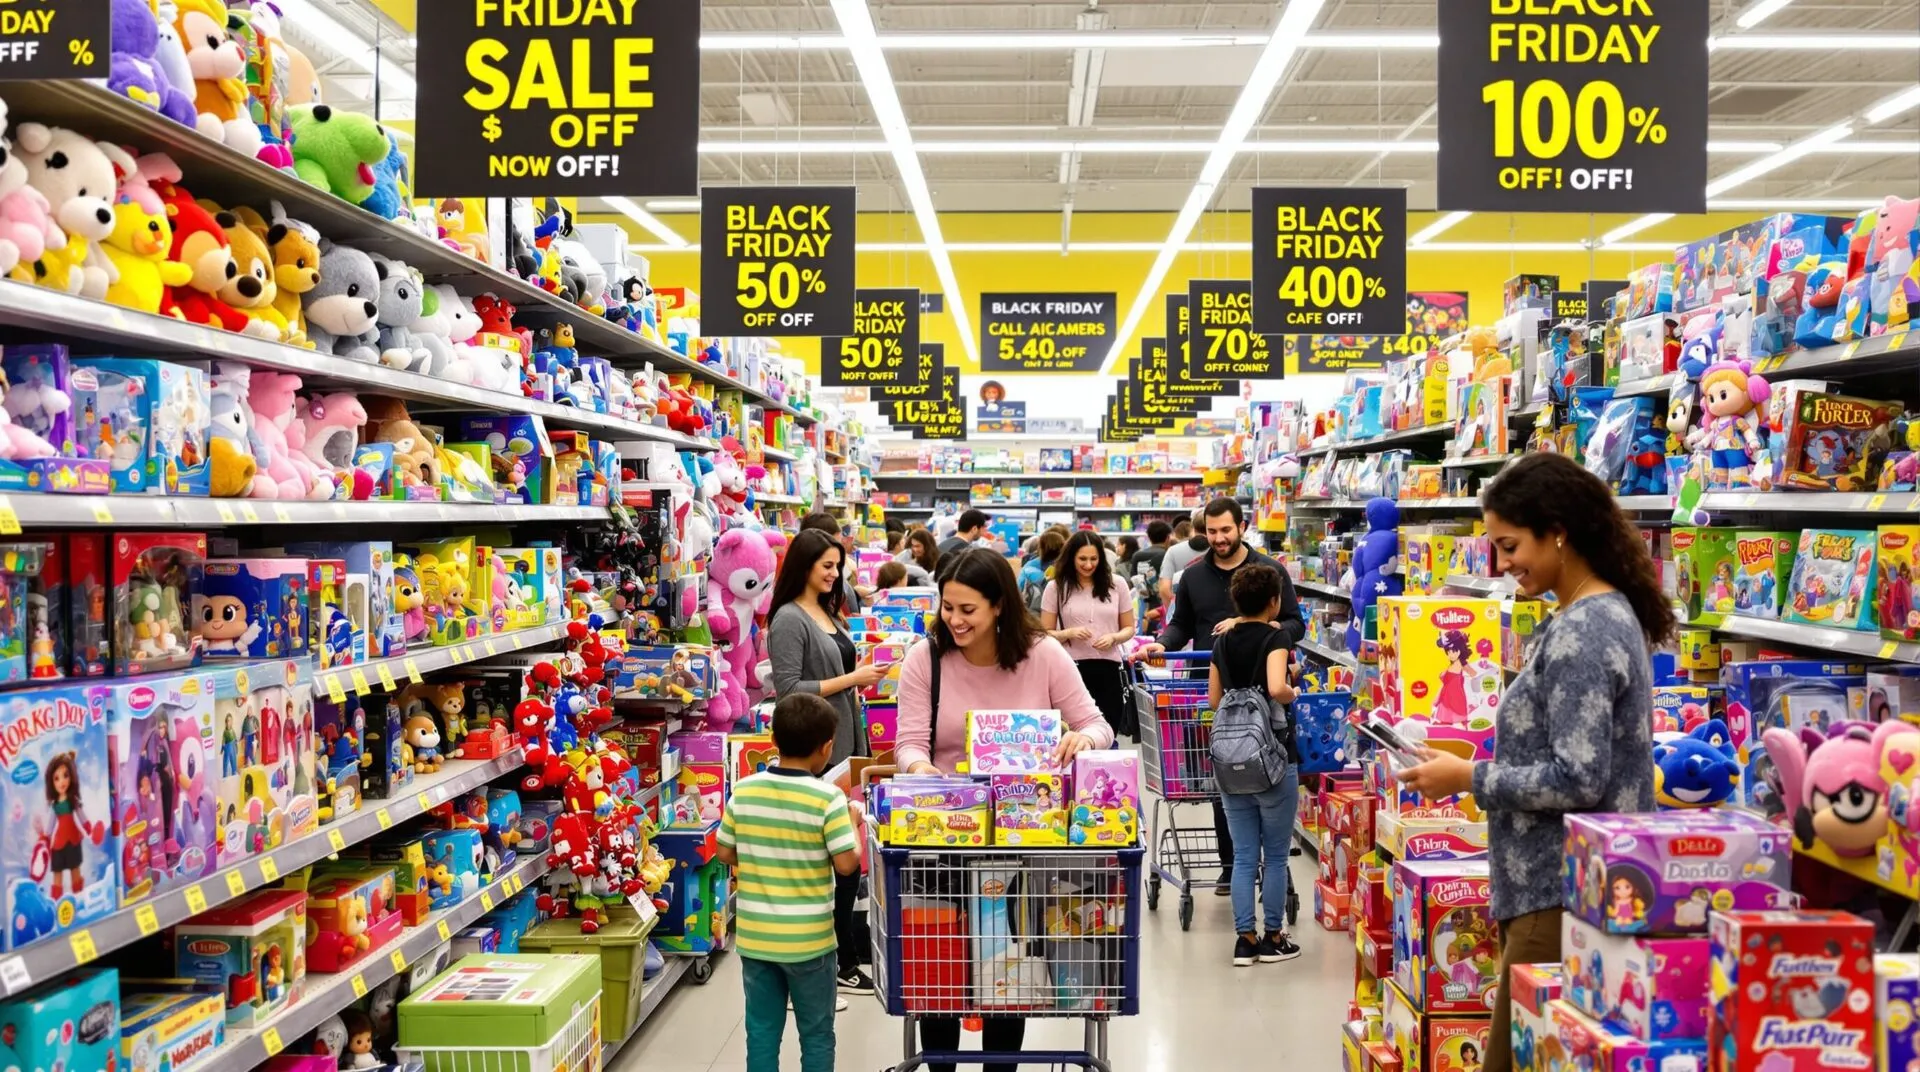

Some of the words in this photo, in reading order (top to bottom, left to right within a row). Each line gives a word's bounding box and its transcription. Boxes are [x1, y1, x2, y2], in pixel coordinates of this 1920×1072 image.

[477, 0, 636, 26] FRIDAY
[69, 40, 94, 65] %
[1491, 23, 1660, 63] FRIDAY
[463, 38, 653, 110] SALE
[482, 114, 502, 142] $
[551, 114, 638, 147] OFF
[1483, 80, 1666, 159] 100%
[490, 155, 551, 176] NOW
[557, 155, 619, 177] OFF!
[1499, 168, 1562, 189] OFF!
[1570, 168, 1632, 190] OFF!
[727, 205, 830, 230] BLACK
[1278, 207, 1382, 231] BLACK
[727, 233, 832, 257] FRIDAY
[1277, 235, 1383, 258] FRIDAY
[736, 262, 826, 308] 50%
[1279, 266, 1386, 307] 400%
[992, 302, 1041, 314] BLACK
[1046, 302, 1103, 314] FRIDAY
[1202, 293, 1251, 308] BLAC
[744, 313, 776, 326] OFF
[781, 313, 814, 326] OFF
[856, 319, 906, 333] RIDAY
[989, 323, 1024, 335] CALL
[1201, 310, 1252, 324] FRIDA
[1287, 313, 1322, 324] CAFE
[1327, 313, 1361, 324] OFF!
[840, 337, 902, 368] 50%
[1062, 347, 1087, 357] OFF
[1204, 329, 1266, 360] 70%
